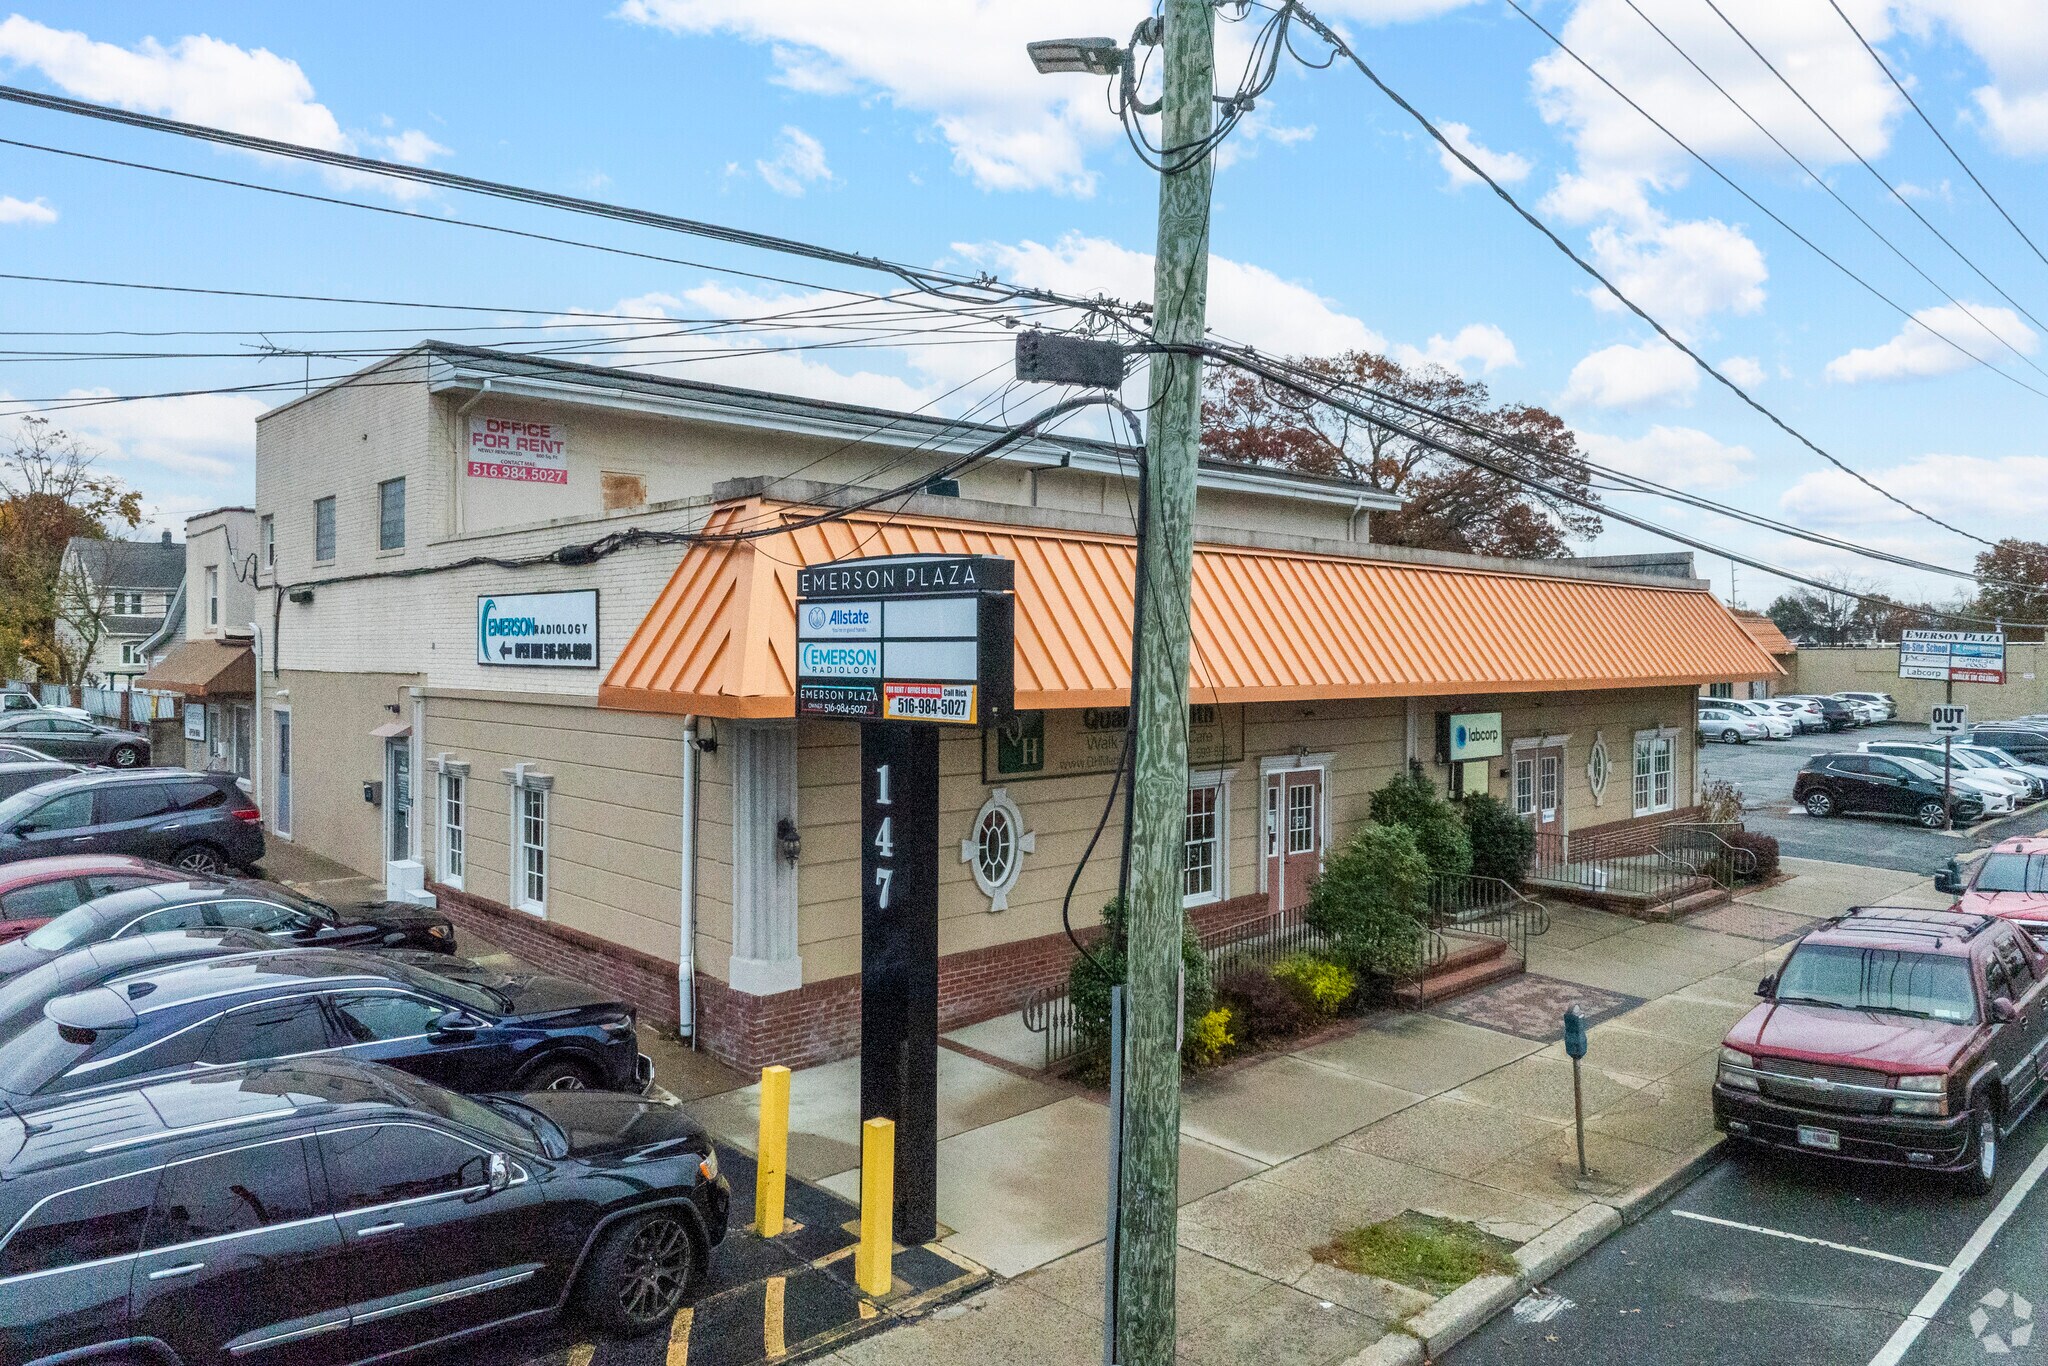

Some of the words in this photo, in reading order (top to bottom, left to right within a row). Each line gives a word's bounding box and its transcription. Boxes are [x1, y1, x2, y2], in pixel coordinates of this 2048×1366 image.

[486, 418, 551, 438] OFFICE
[472, 432, 510, 449] FOR
[516, 437, 565, 454] RENT
[473, 463, 563, 482] 516.984.5027
[801, 569, 895, 592] EMERSON
[906, 565, 976, 587] PLAZA
[829, 609, 869, 625] Allstate
[488, 617, 535, 636] EMERSON
[535, 623, 588, 635] RADIOLOGY
[1926, 643, 1948, 653] School
[811, 648, 877, 666] EMERSON
[812, 666, 877, 675] RADIOLOGY
[1906, 669, 1941, 677] Labcorp
[800, 689, 844, 700] EMERSON
[848, 691, 879, 702] PLAZA
[943, 688, 954, 697] Call
[824, 703, 868, 715] 516-984-5027
[897, 698, 966, 716] 516-984-5027
[1932, 707, 1964, 723] OUT
[1468, 727, 1498, 742] labcorp
[875, 764, 893, 909] 147
